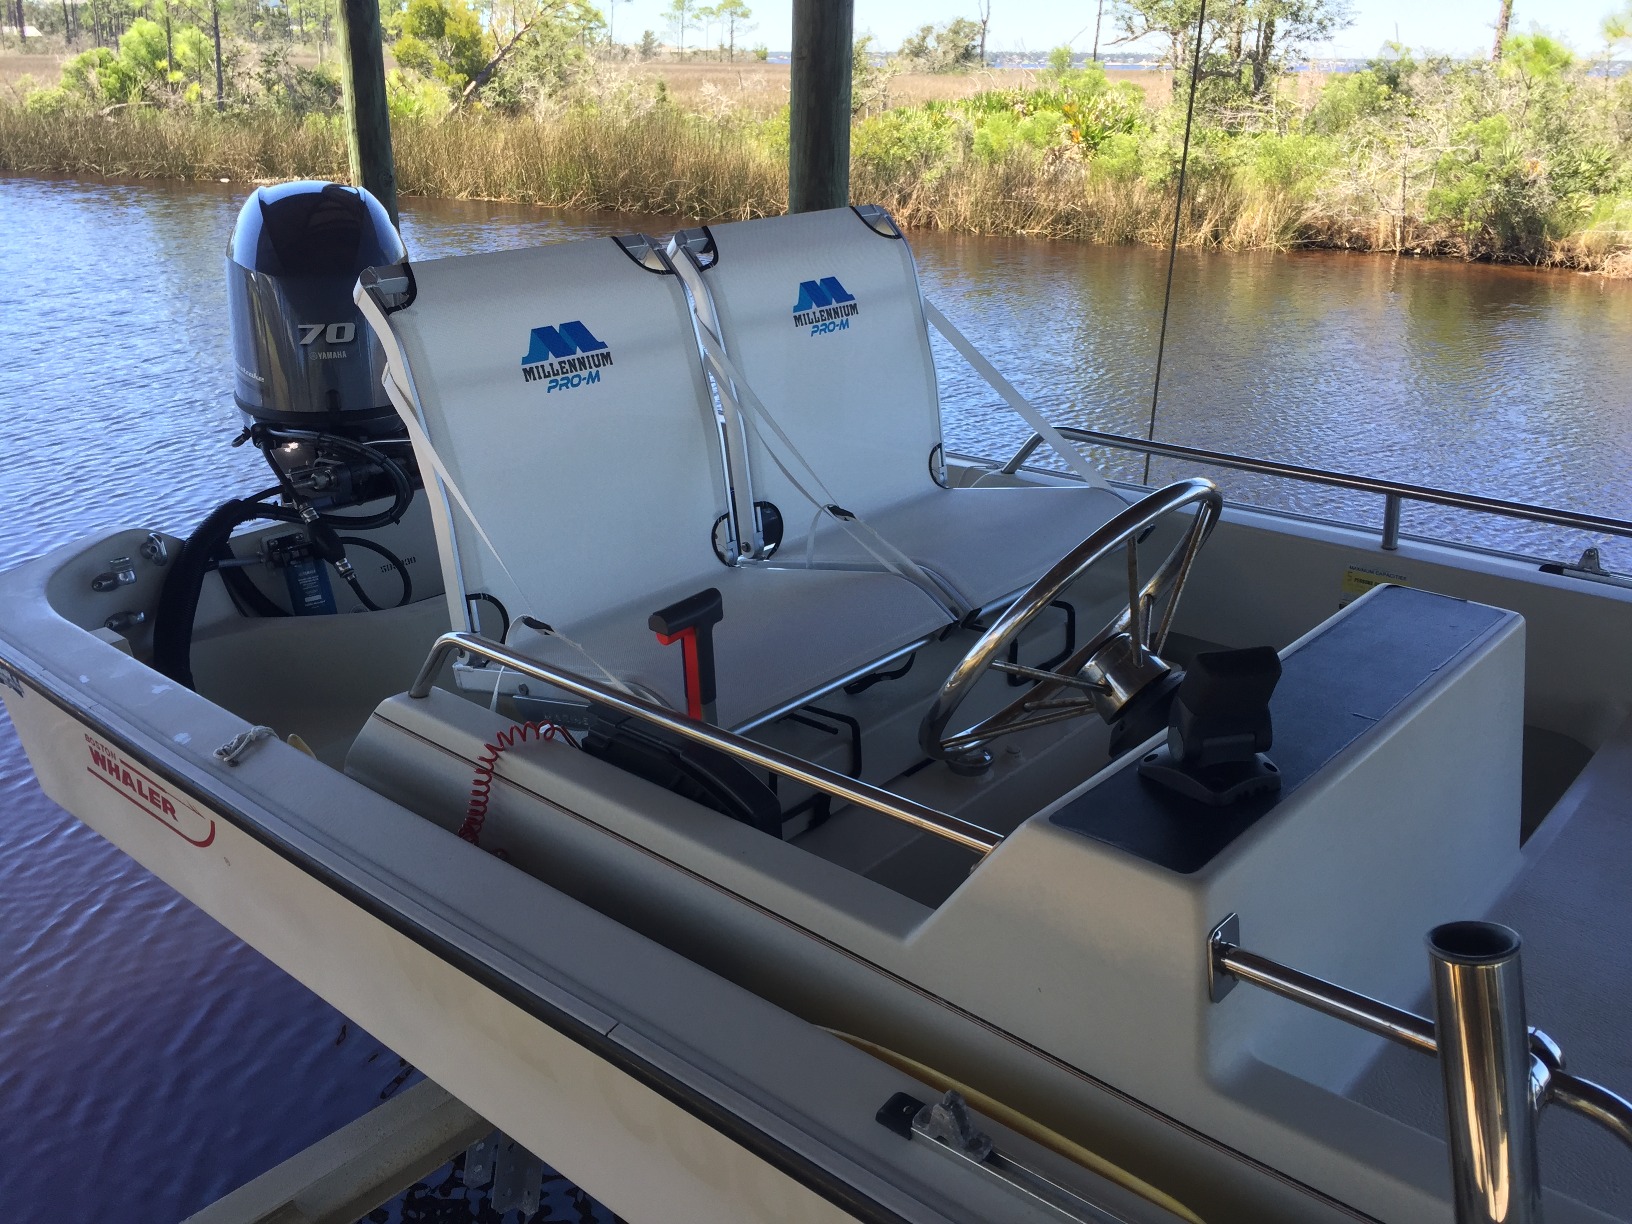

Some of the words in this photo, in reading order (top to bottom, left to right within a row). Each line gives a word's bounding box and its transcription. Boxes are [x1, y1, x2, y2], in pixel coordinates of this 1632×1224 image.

[793, 303, 859, 328] MILLENNIUM
[810, 317, 850, 338] PRO-M
[297, 322, 356, 345] 70
[317, 351, 348, 360] YAMAHA
[522, 351, 614, 383] MILLENNIUM
[546, 369, 601, 394] PRO-M
[84, 733, 117, 761] BOSTON
[88, 745, 179, 822] WHALER
